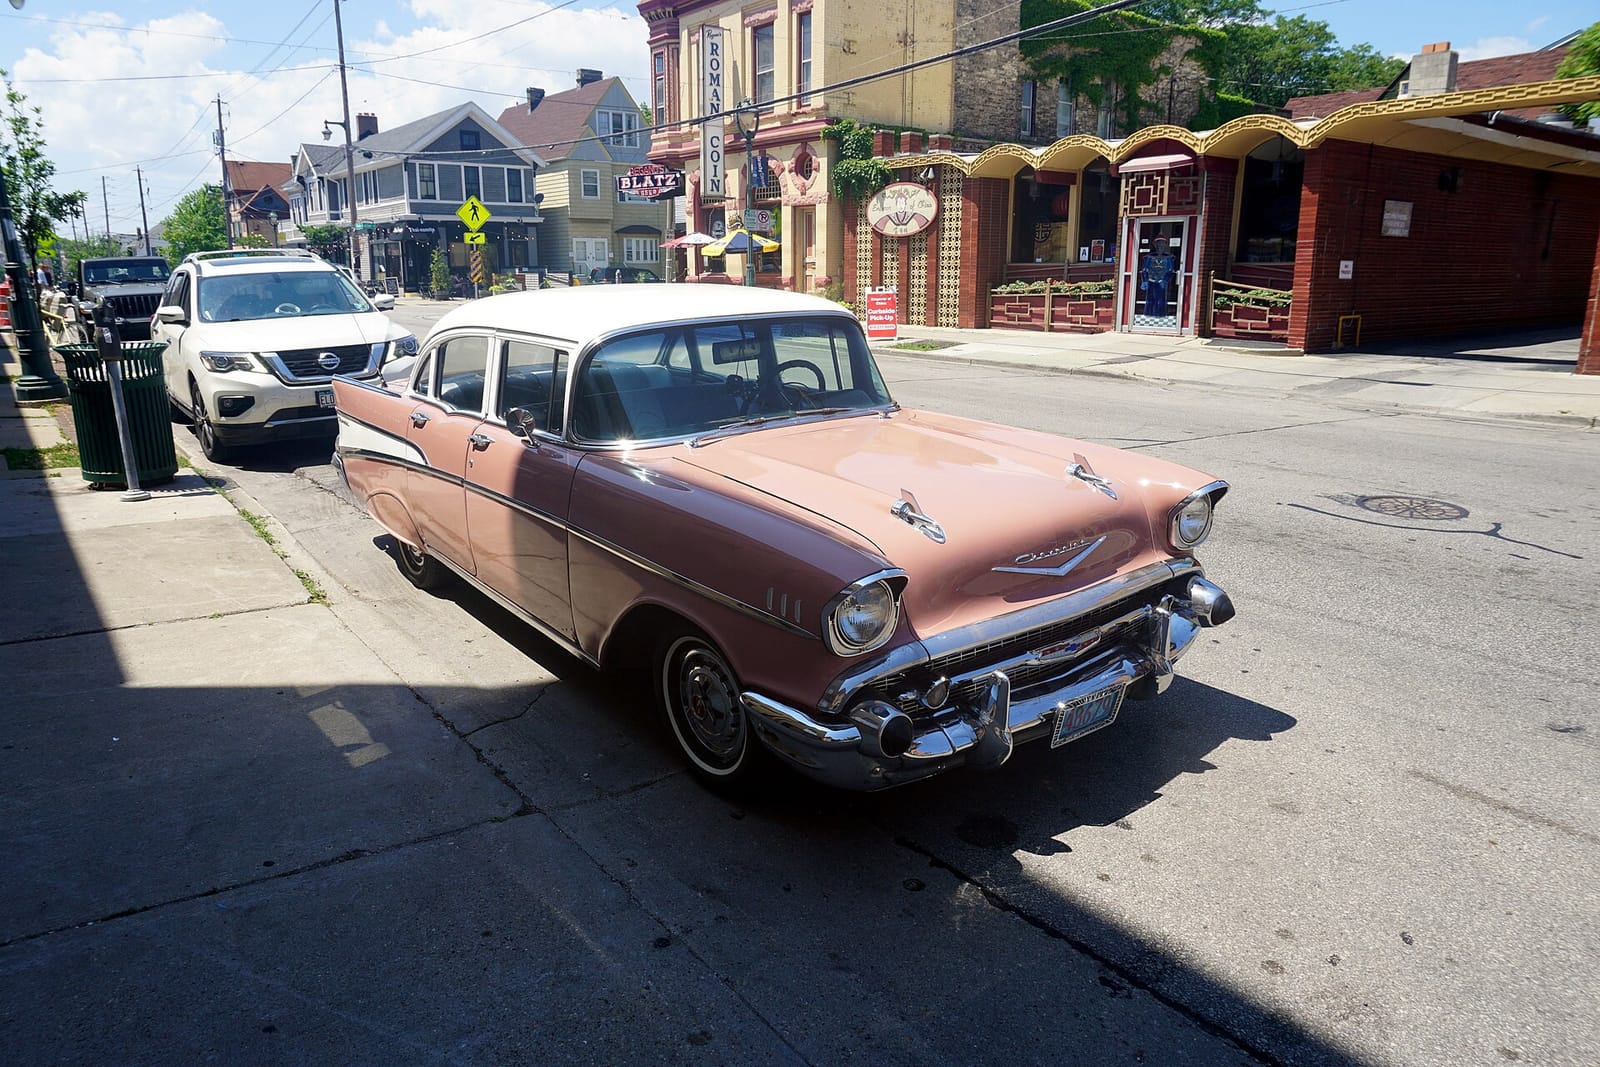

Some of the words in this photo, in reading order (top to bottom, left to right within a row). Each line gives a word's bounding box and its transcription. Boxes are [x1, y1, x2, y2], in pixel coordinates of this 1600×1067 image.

[709, 42, 721, 115] ROMAN
[710, 135, 721, 193] COIN
[620, 174, 676, 189] BLATZ
[1082, 249, 1087, 257] A
[869, 314, 894, 322] Pick-Up
